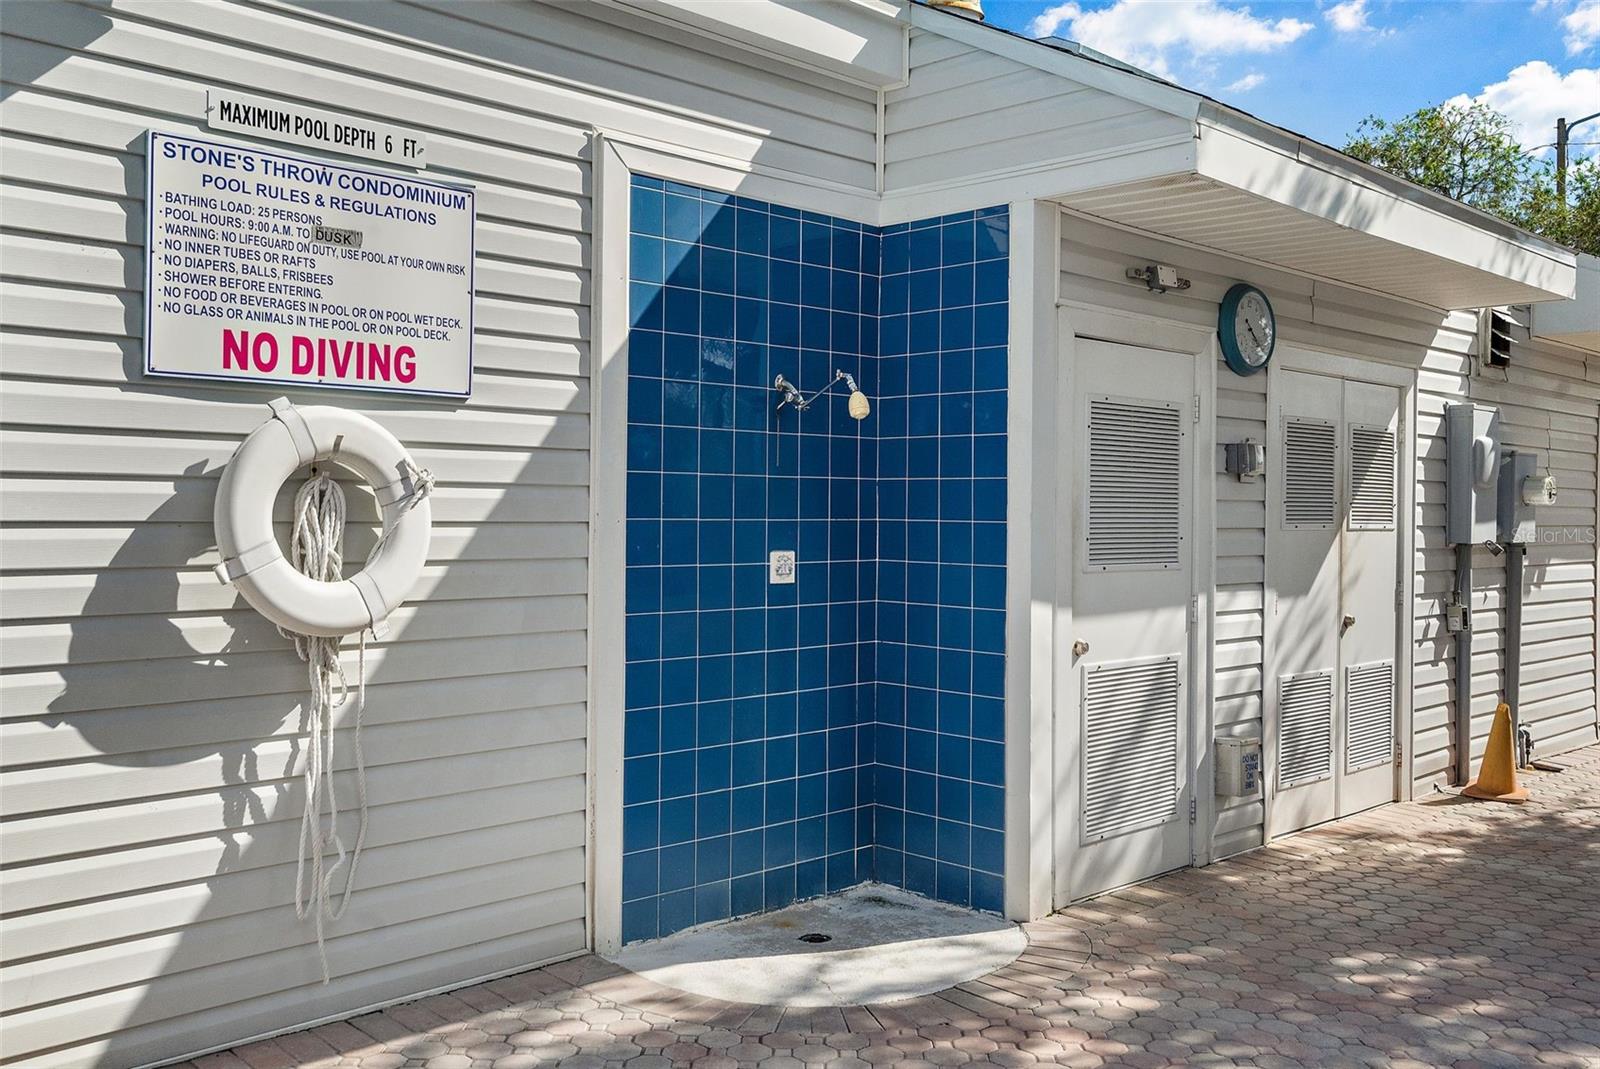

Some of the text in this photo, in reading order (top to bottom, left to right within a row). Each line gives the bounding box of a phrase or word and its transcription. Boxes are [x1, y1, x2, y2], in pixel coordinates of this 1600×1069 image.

[220, 100, 417, 158] MAXIMUM POOL DEPTH 6 FT
[163, 142, 466, 210] STONE'S THROW CONDOMINIUM
[165, 191, 323, 226] BATHING LOAD: 25 PERSONS
[202, 174, 437, 226] POOL RULES & REGULATIONS
[165, 207, 198, 222] POOL
[201, 212, 245, 229] HOURS:
[248, 220, 269, 232] 9:00
[272, 223, 294, 237] A.M.
[296, 227, 310, 239] TO
[164, 238, 316, 269] NO INNER TUBES OR RAFTS
[164, 254, 334, 286] NO DIAPERS, BALLS, FRISBEES
[165, 223, 466, 276] WARNING: NO LIFEGUARD ON DUTY, USE POOL AT YOUR OWN RISK
[164, 270, 323, 299] SHOWER BEFORE ENTERING.
[163, 286, 463, 329] NO FOOD OR BEVERAGES IN POOL OR ON POOL WET DECK.
[163, 301, 451, 341] NO GLASS OR ANIMALS IN THE POOL OR ON POOL DECK.
[223, 329, 416, 383] NO DIVING
